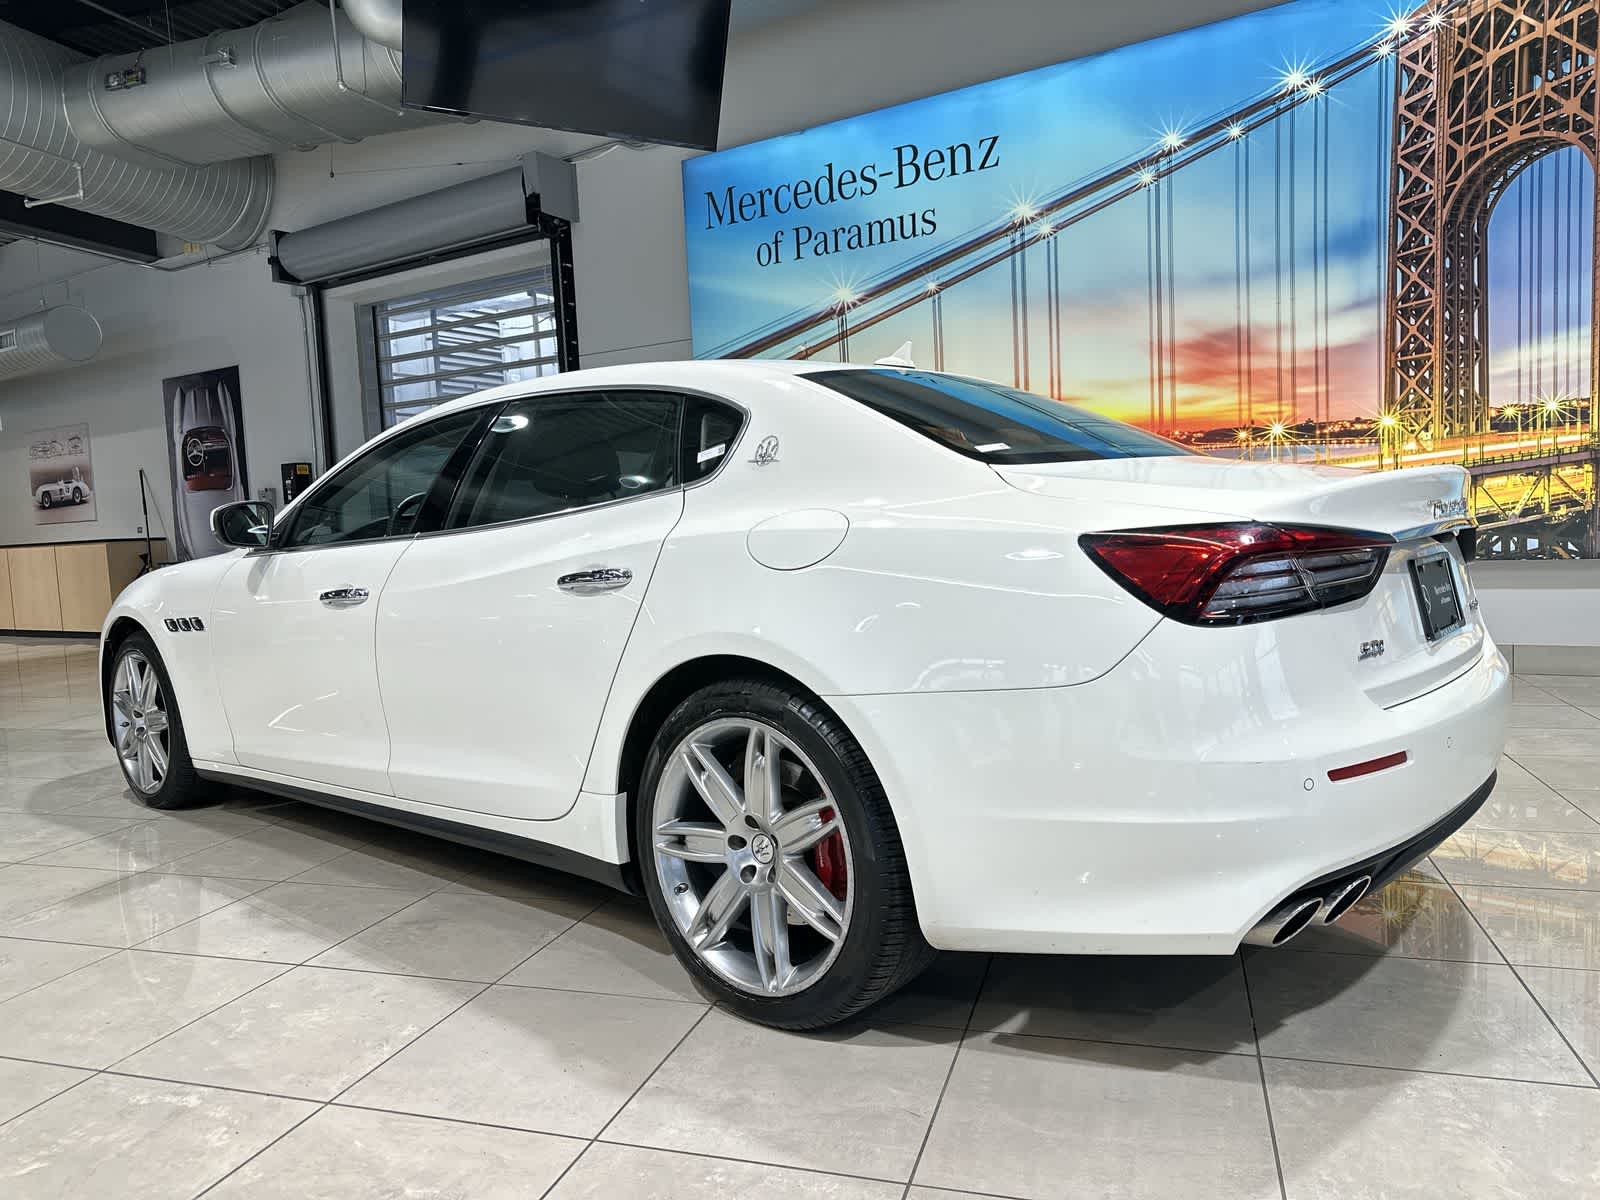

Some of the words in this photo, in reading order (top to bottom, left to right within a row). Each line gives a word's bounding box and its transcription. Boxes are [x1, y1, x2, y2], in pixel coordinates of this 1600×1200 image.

[704, 135, 1000, 230] Mercedes-Benz
[756, 230, 784, 267] of
[792, 207, 937, 261] Paramus
